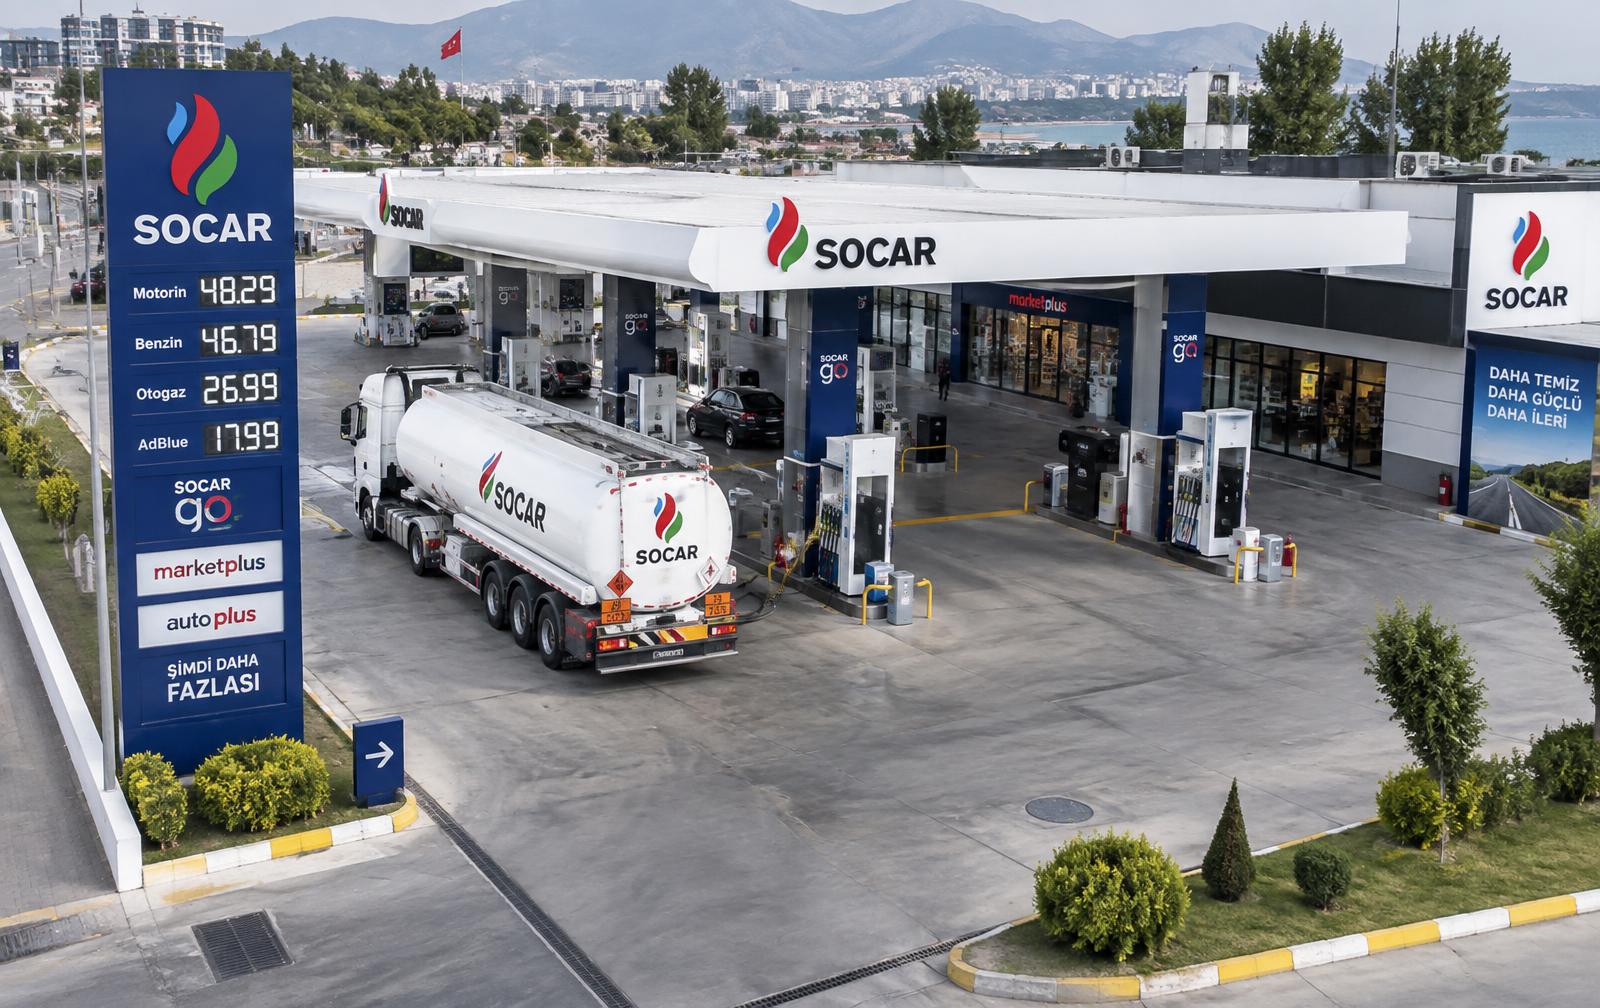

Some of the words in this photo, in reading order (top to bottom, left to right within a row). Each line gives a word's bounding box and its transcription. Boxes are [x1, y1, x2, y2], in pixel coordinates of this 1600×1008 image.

[133, 212, 273, 245] SOCAR
[391, 204, 424, 230] SOCAR
[814, 236, 936, 270] SOCAR
[133, 286, 187, 299] Motorin
[200, 274, 276, 305] 48.29
[1485, 285, 1568, 310] SOCAR
[1009, 293, 1068, 313] marketplus
[135, 337, 183, 350] Benzin
[201, 324, 277, 355] 46.79
[1173, 334, 1198, 343] SOCAR
[820, 353, 849, 363] SOCAR
[1173, 342, 1198, 363] go
[820, 363, 848, 385] go
[1489, 366, 1530, 384] DAHA
[1534, 373, 1580, 392] TEMİZ
[136, 388, 187, 401] Otogaz
[203, 372, 278, 404] 26.99
[1488, 385, 1528, 403] DAHA
[1532, 391, 1582, 411] GÜÇLÜ
[1487, 404, 1527, 422] DAHA
[1531, 408, 1568, 429] İLERİ
[138, 436, 189, 451] AdBlue
[215, 421, 280, 452] 17.99
[174, 477, 231, 495] SOCAR
[175, 495, 232, 533] go
[494, 481, 546, 533] SOCAR
[154, 554, 266, 580] marketplus
[635, 544, 699, 566] SOCAR
[167, 657, 212, 680] ŞİMDİ
[216, 653, 259, 671] DAHA
[167, 672, 260, 703] FAZLASI
